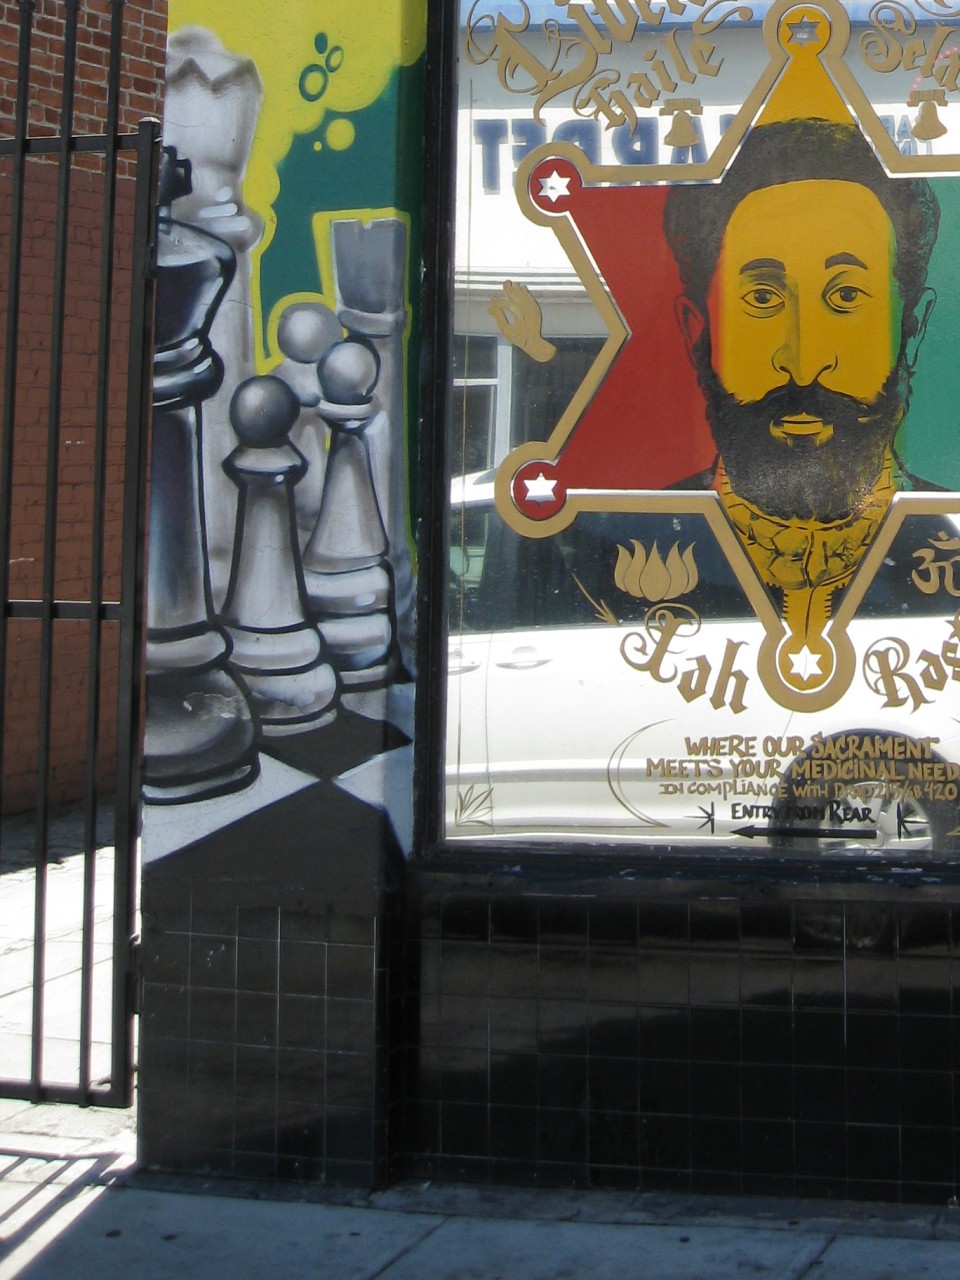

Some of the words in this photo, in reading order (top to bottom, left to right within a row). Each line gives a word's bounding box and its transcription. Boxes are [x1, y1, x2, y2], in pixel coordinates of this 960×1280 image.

[684, 734, 757, 759] WHERE
[763, 734, 807, 760] OUR
[810, 731, 940, 761] SACRAMENT
[645, 758, 724, 780] MEETS
[729, 758, 786, 781] YOUR
[658, 782, 684, 796] IN
